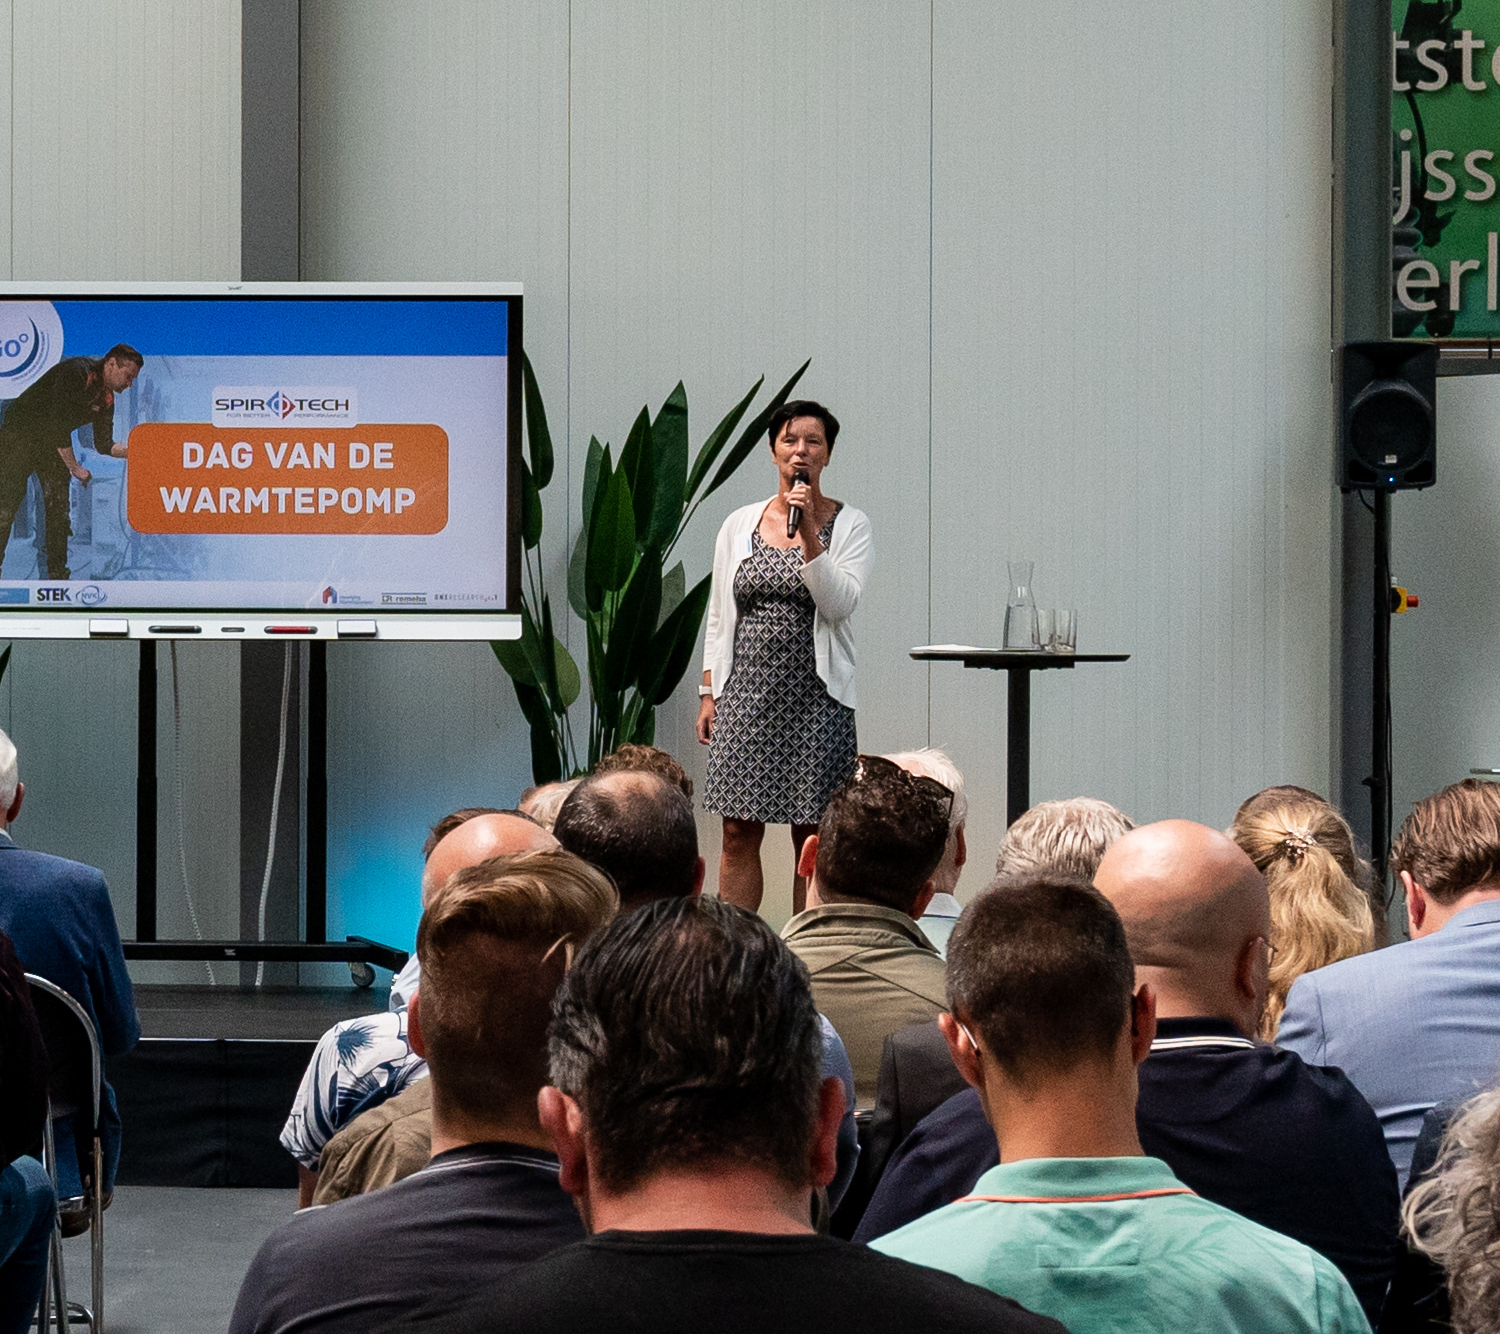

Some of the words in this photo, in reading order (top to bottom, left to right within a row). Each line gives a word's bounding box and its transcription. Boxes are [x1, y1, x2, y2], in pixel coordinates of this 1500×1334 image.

[182, 442, 253, 469] DAG
[264, 442, 335, 469] VAN
[349, 442, 394, 469] DE
[159, 486, 416, 514] WARMTEPOMP
[36, 587, 72, 602] STEK
